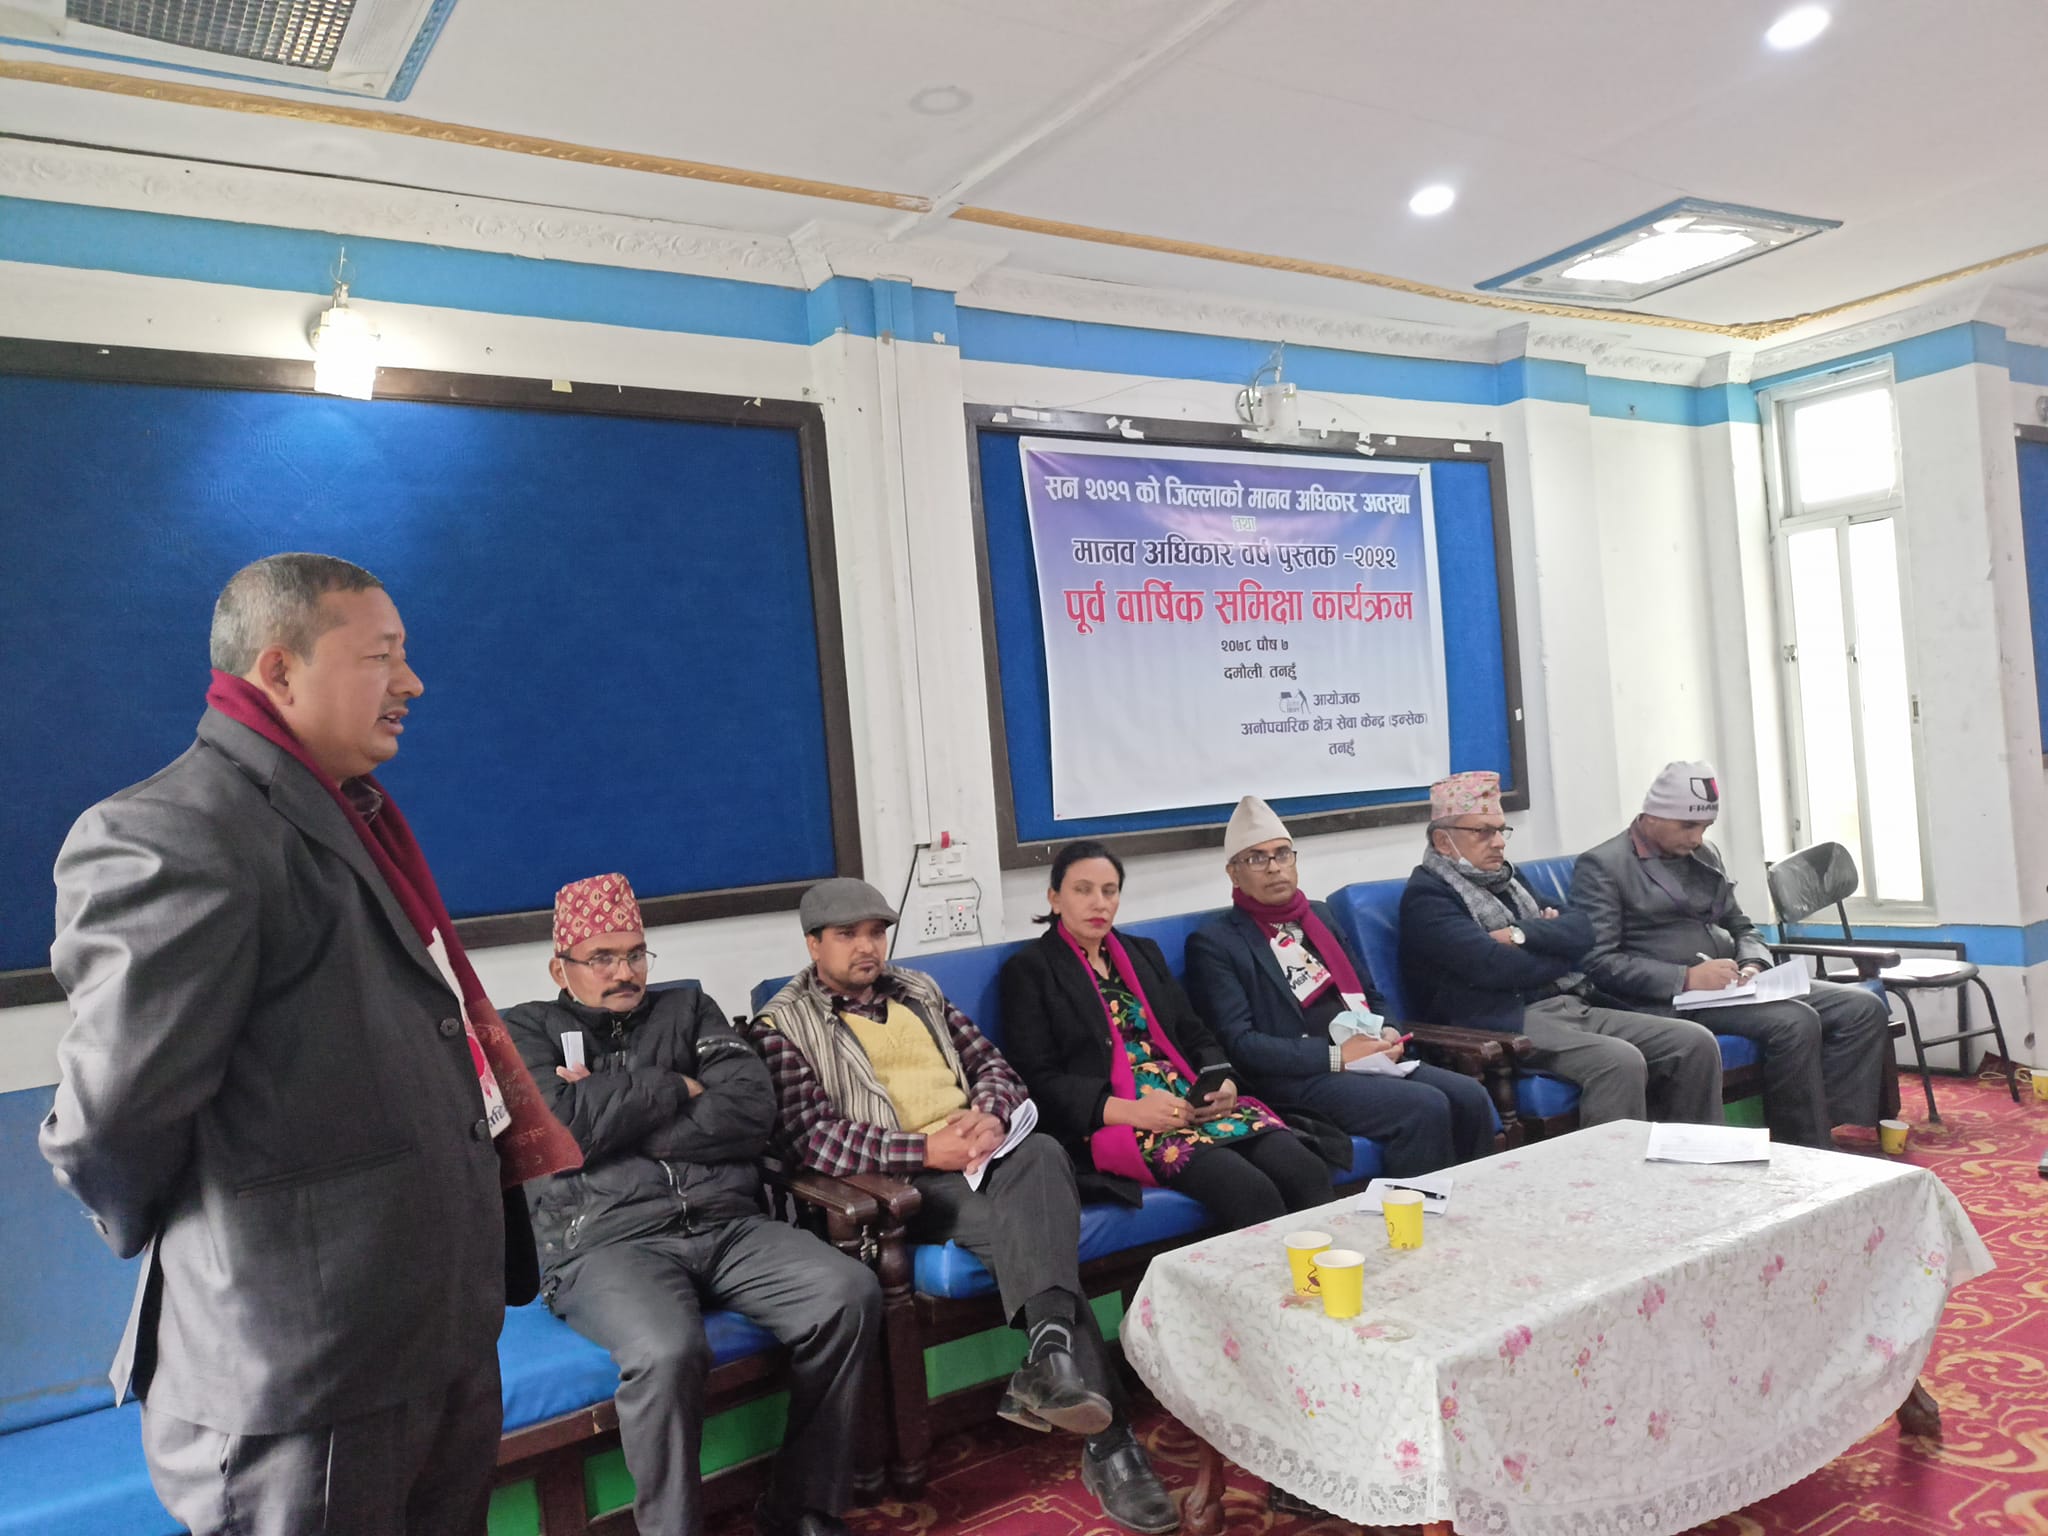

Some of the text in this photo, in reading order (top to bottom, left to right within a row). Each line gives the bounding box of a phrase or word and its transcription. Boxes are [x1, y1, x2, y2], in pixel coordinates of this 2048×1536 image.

[1044, 475, 1080, 500] सन
[1085, 477, 1131, 502] २०२१
[1135, 475, 1160, 504] को
[1165, 475, 1244, 508] जिल्लाको
[1248, 487, 1292, 510] मानव
[1361, 493, 1411, 515] अवस्था
[1072, 538, 1136, 565] मानव
[1144, 533, 1235, 567] अधिकार
[1240, 537, 1270, 567] वर्ष
[1275, 544, 1338, 574] पुस्तक
[1063, 578, 1413, 634] पूर्व वार्षिक समिक्षा कार्यक्रम
[1221, 639, 1252, 652] २०७८
[1281, 639, 1289, 651] ७
[1313, 689, 1360, 706] आयोजक
[1336, 713, 1357, 730] सेवा
[1360, 712, 1385, 729] केन्द्र
